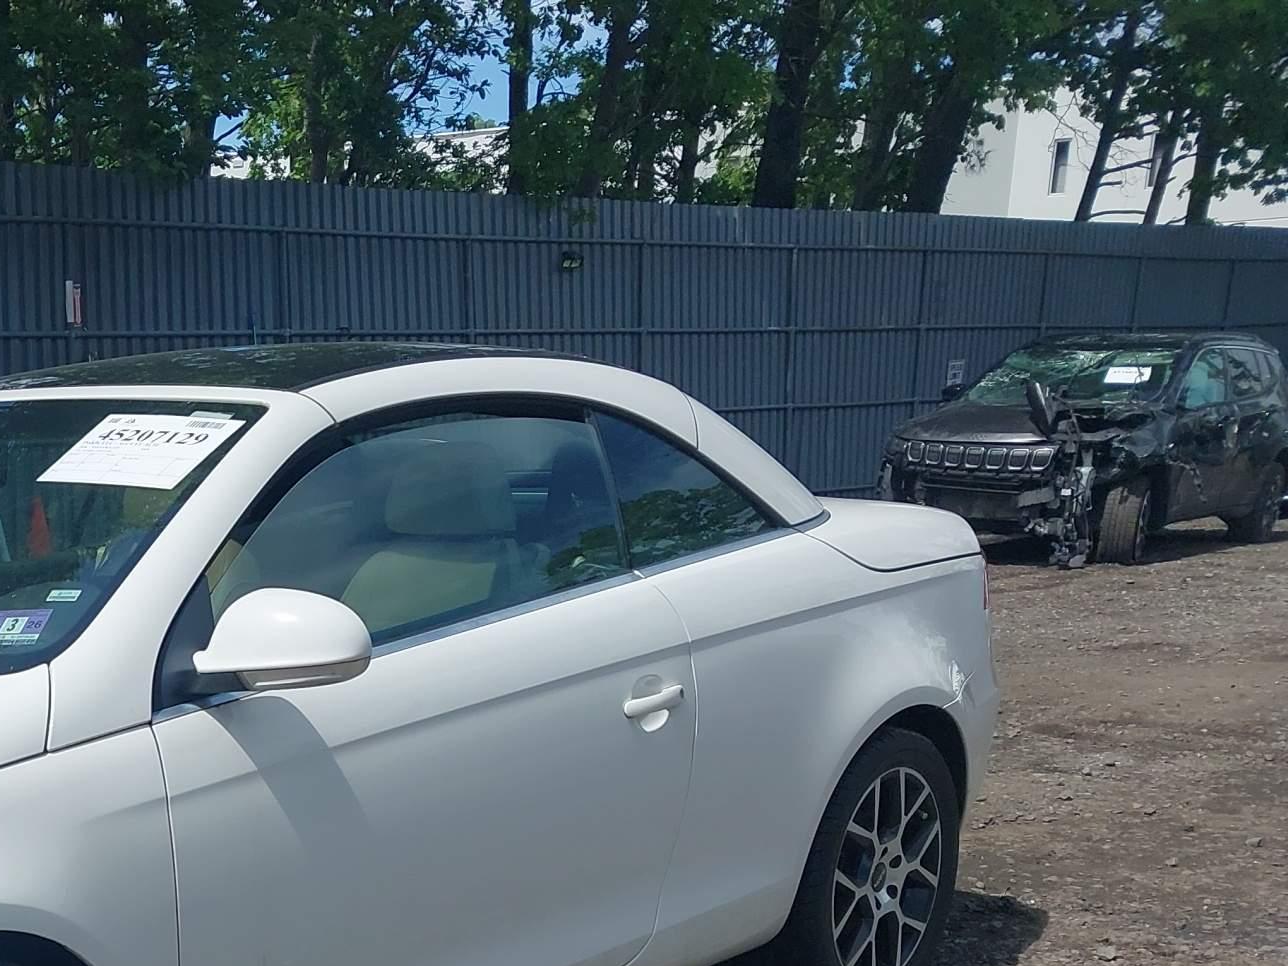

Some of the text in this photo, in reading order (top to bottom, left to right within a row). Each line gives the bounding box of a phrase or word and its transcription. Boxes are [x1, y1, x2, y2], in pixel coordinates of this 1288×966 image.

[98, 428, 209, 446] 45207129
[6, 618, 20, 632] 3
[26, 620, 43, 629] 26
